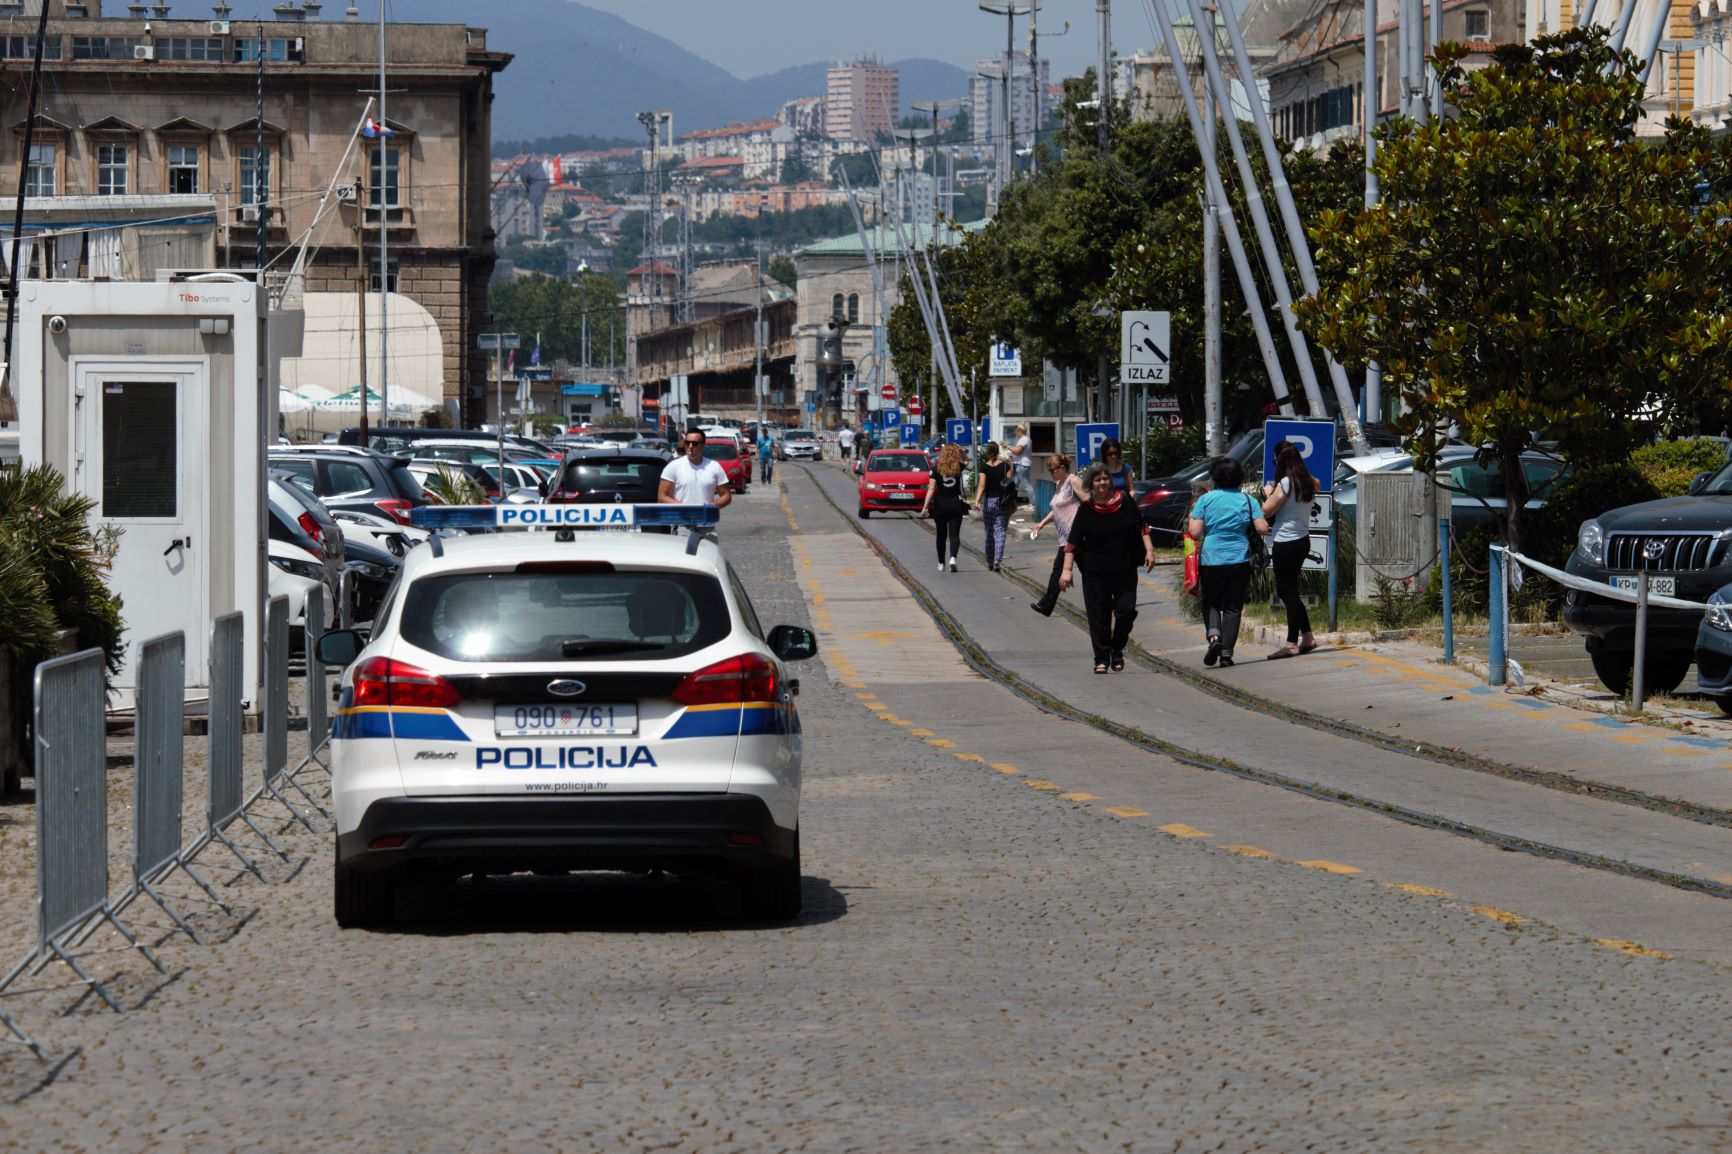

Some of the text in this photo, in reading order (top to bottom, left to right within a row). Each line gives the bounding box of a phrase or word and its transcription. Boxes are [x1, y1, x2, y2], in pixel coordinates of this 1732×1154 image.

[179, 293, 231, 304] Tibo Systems
[1128, 368, 1164, 380] IZLAZ
[888, 413, 896, 424] P
[905, 427, 914, 439] P
[953, 424, 965, 440] P
[1089, 432, 1107, 460] P
[502, 508, 627, 524] POLICIJA
[514, 706, 615, 729] 090 761
[475, 745, 659, 769] POLICIJA
[525, 781, 609, 793] www.policija.hr
